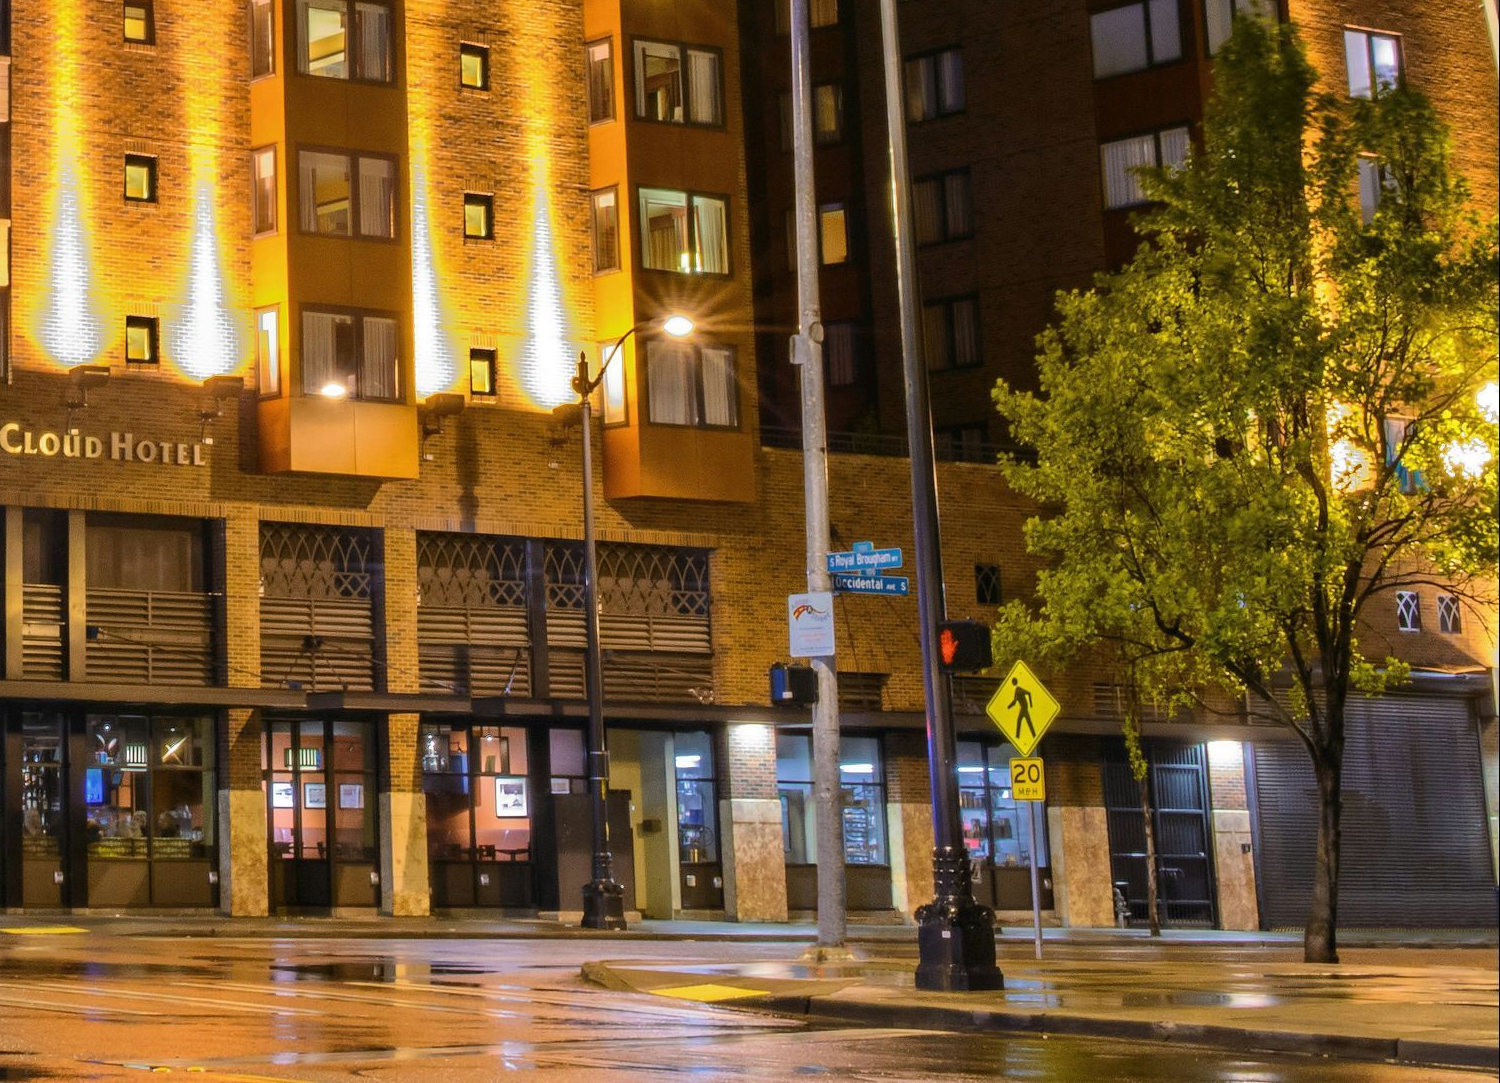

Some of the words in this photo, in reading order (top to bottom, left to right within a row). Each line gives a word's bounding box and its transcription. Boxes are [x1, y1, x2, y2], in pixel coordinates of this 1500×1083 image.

[110, 431, 207, 466] HOTEL
[829, 557, 835, 567] S
[835, 576, 884, 591] Occidental
[900, 581, 908, 592] S
[1013, 763, 1040, 784] 20
[1018, 787, 1039, 796] MPH
